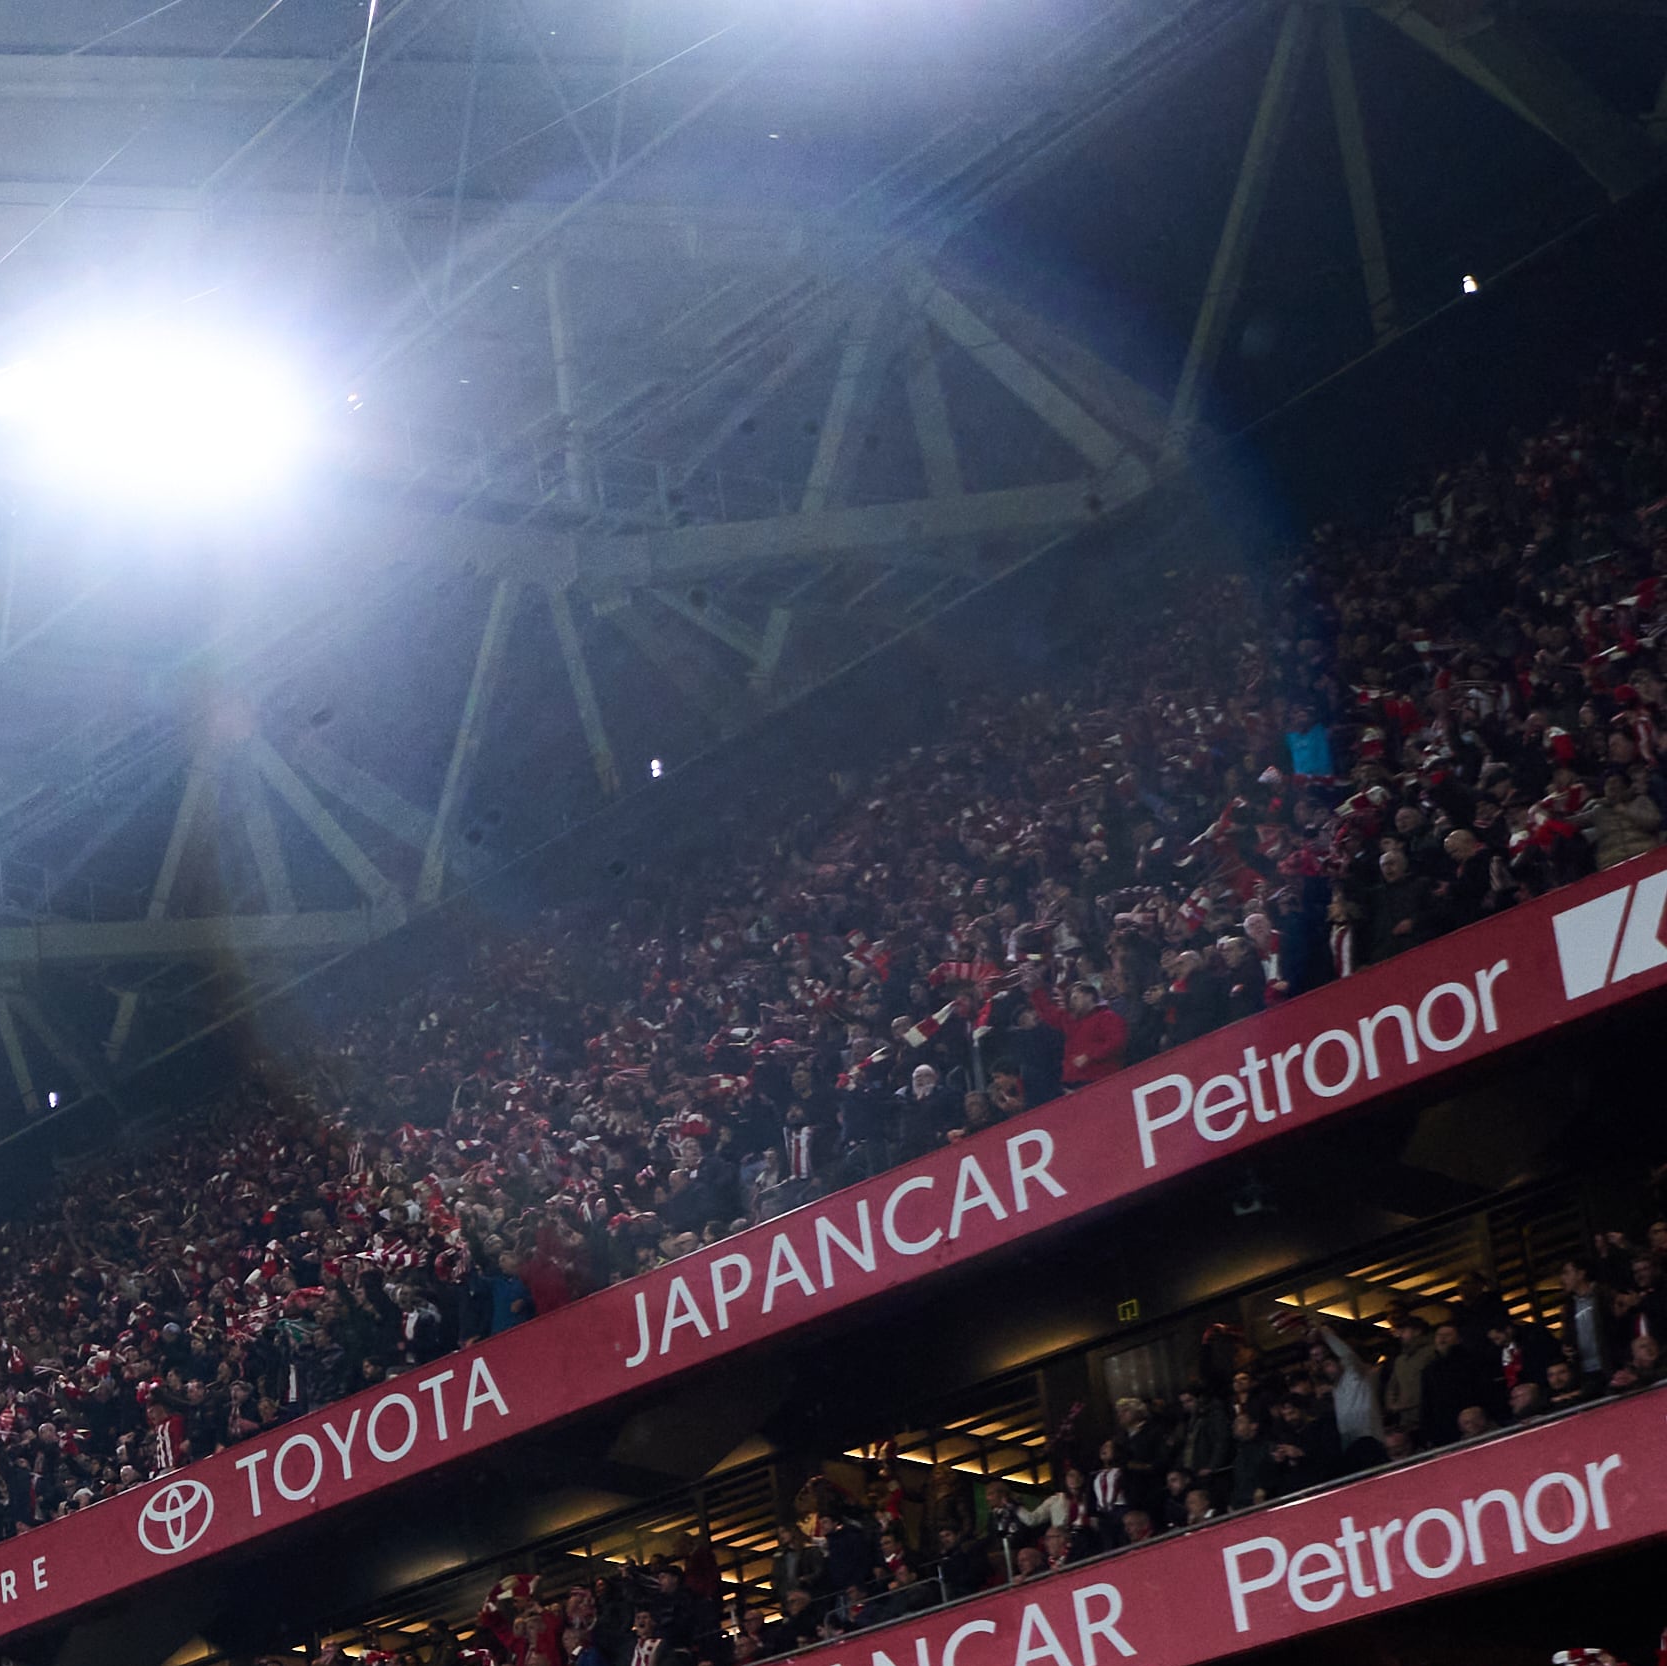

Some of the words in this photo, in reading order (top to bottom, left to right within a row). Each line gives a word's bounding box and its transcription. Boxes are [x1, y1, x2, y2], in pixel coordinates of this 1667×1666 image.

[1132, 958, 1509, 1168] Petronor
[625, 1128, 1068, 1368] JAPANCAR
[235, 1356, 510, 1517] TOYOTA
[1221, 1454, 1622, 1632] Petronor
